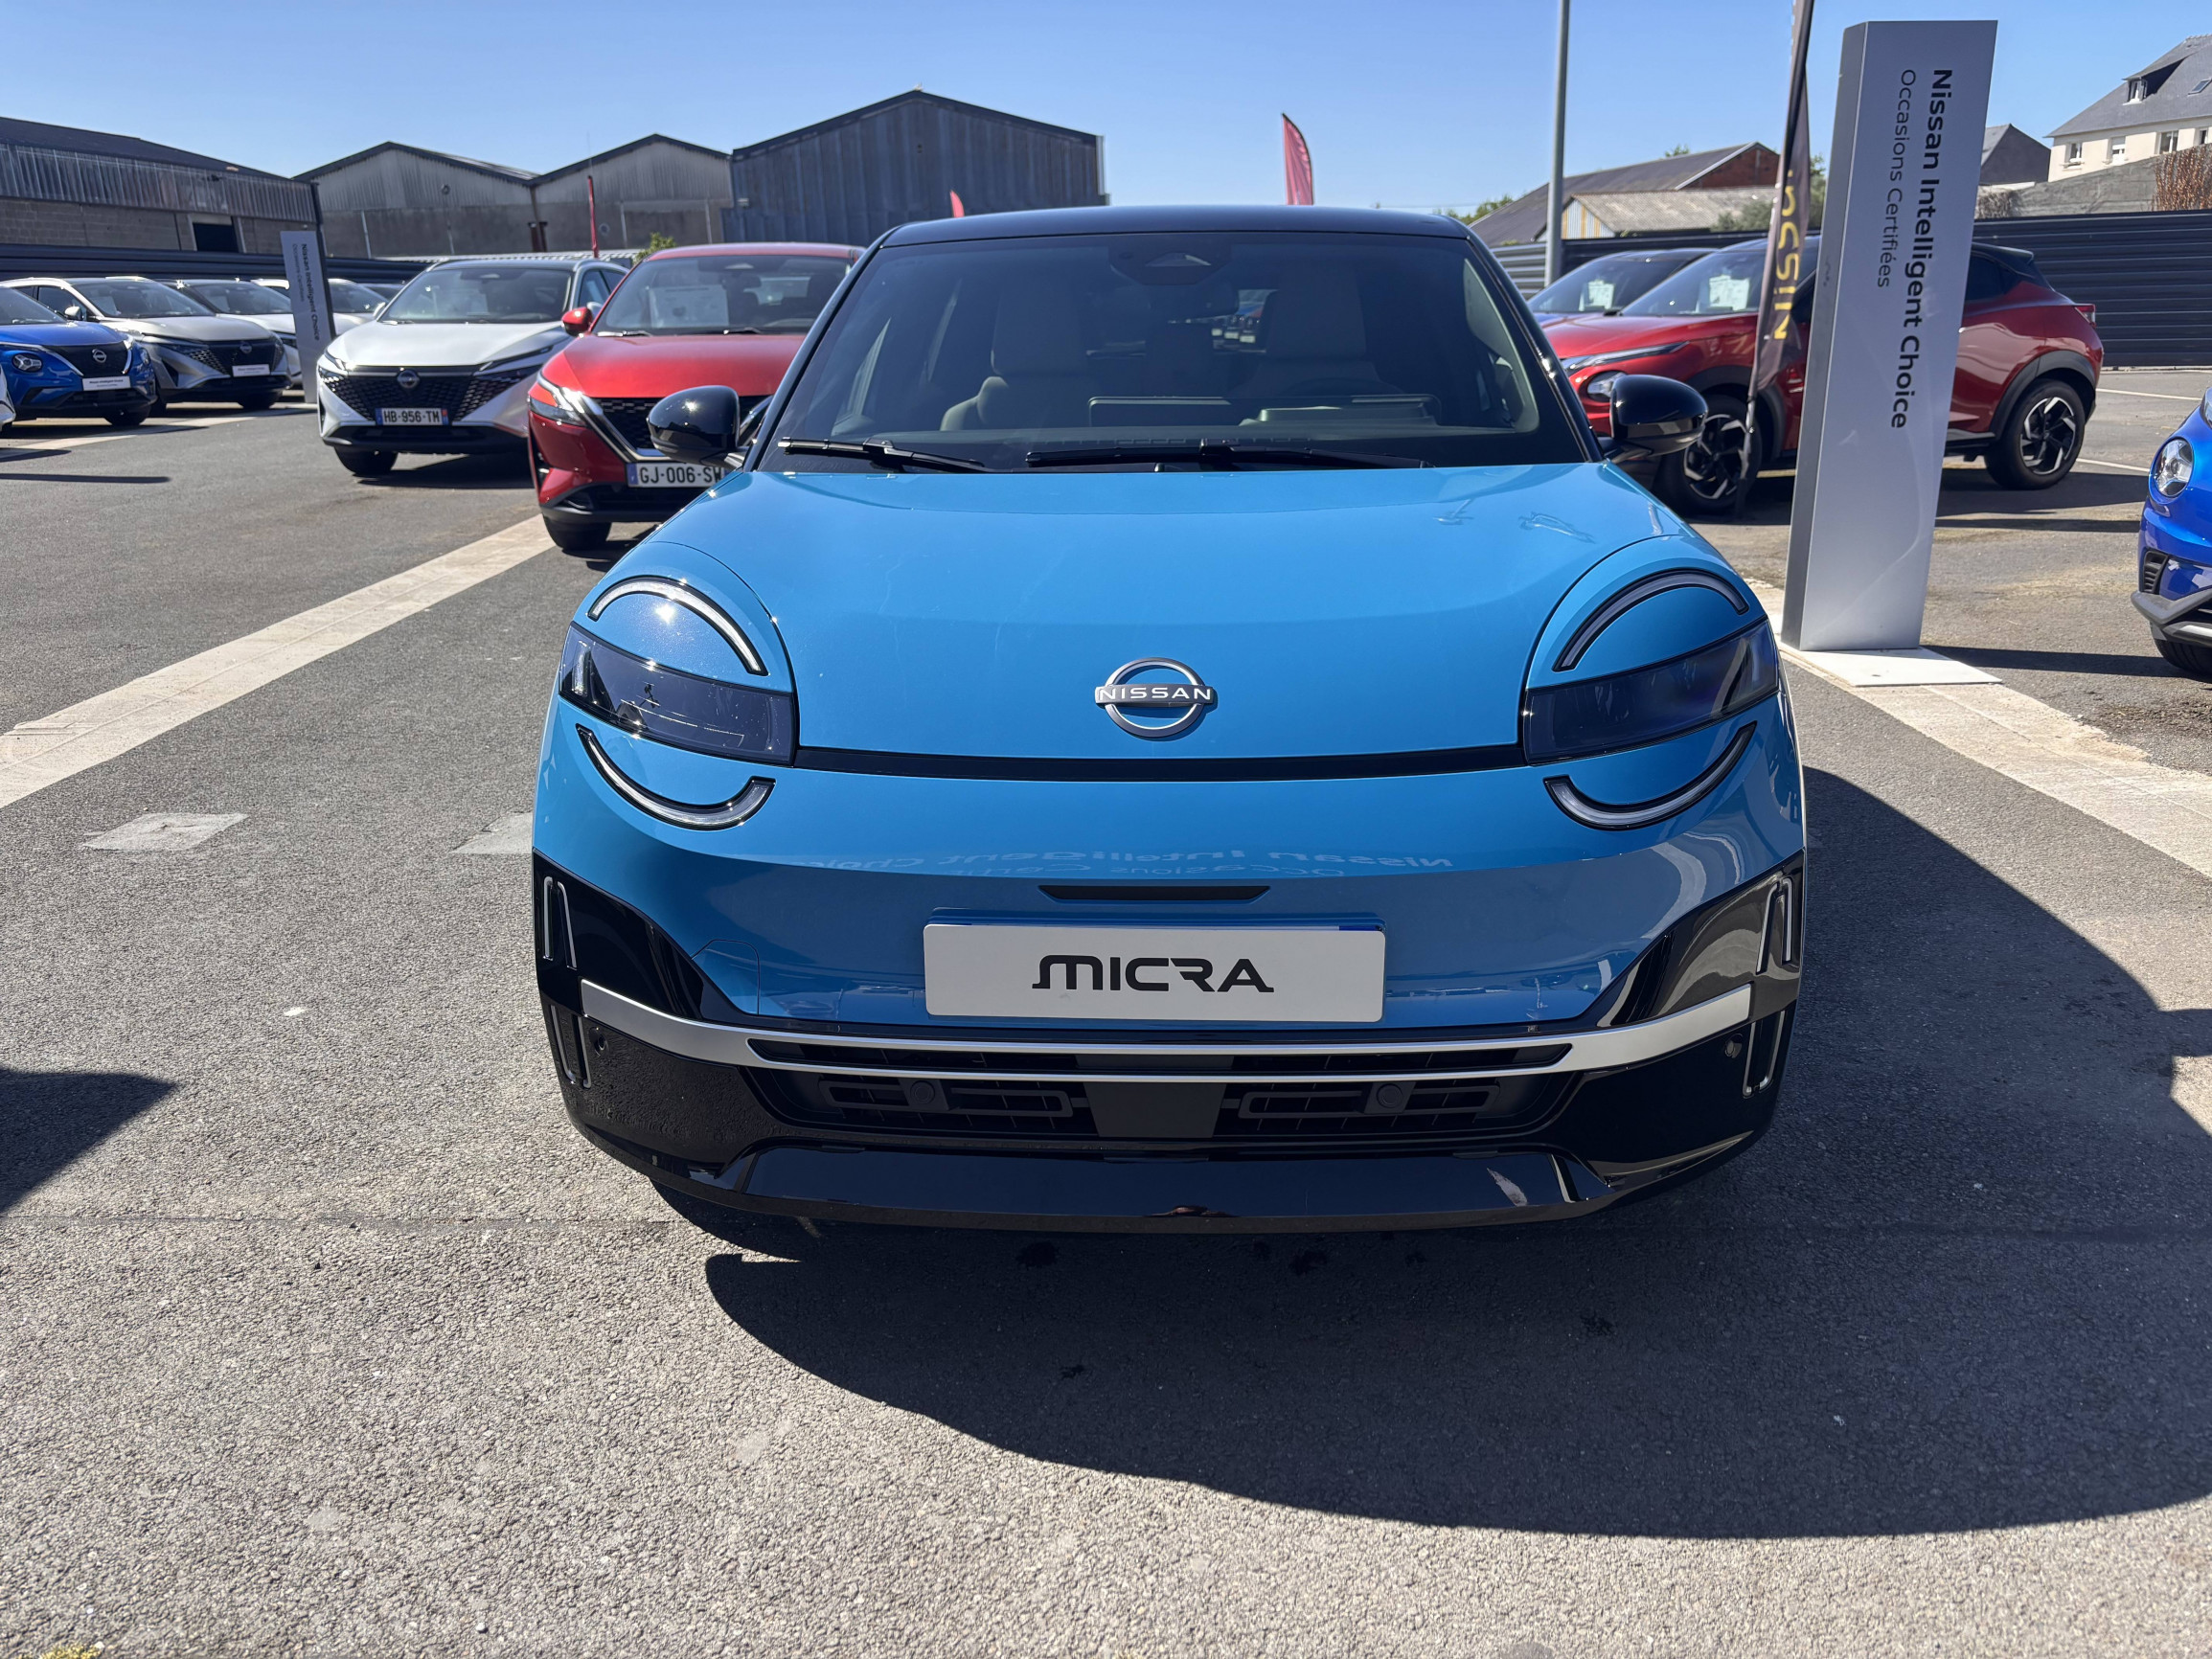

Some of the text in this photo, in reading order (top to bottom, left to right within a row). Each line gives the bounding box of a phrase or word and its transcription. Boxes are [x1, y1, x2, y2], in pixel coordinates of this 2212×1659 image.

[1877, 69, 1916, 287] Occasions Certifiées
[1890, 69, 1953, 428] Nissan Intelligent Choice
[1099, 687, 1211, 700] NISSAN
[1031, 954, 1274, 993] MICRA
